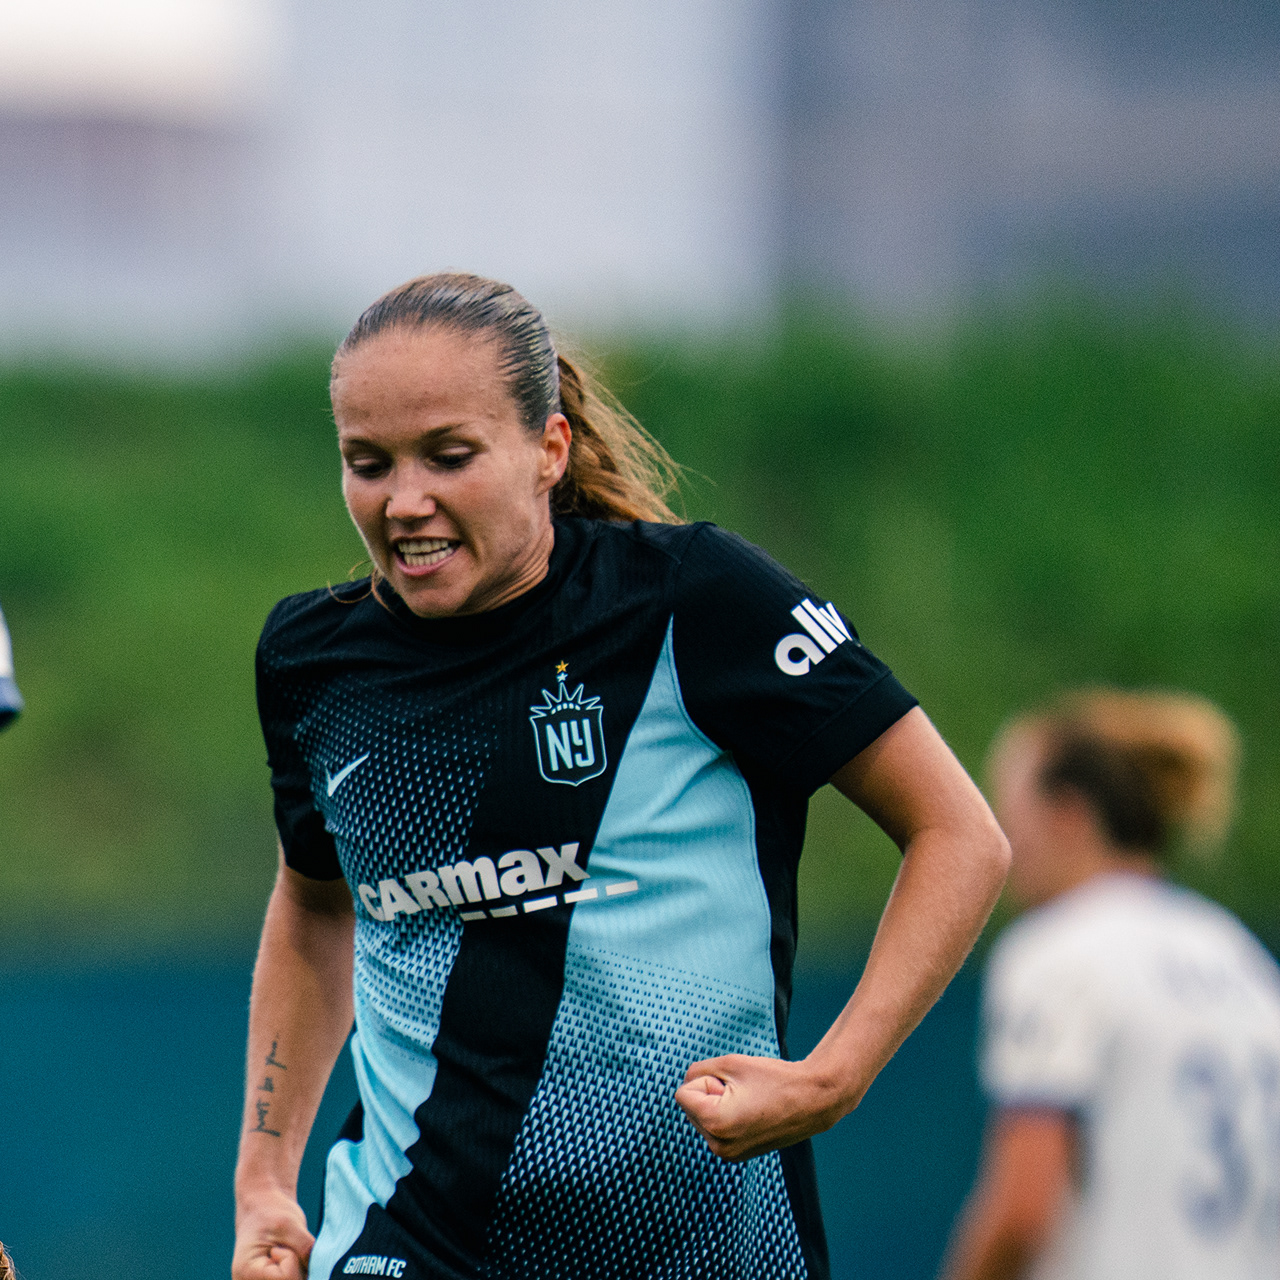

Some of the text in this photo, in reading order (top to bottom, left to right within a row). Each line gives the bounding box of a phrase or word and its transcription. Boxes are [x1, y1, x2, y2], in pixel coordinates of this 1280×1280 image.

[774, 596, 854, 677] ally
[544, 717, 596, 772] NY
[342, 1255, 408, 1279] GOTHAM FC
